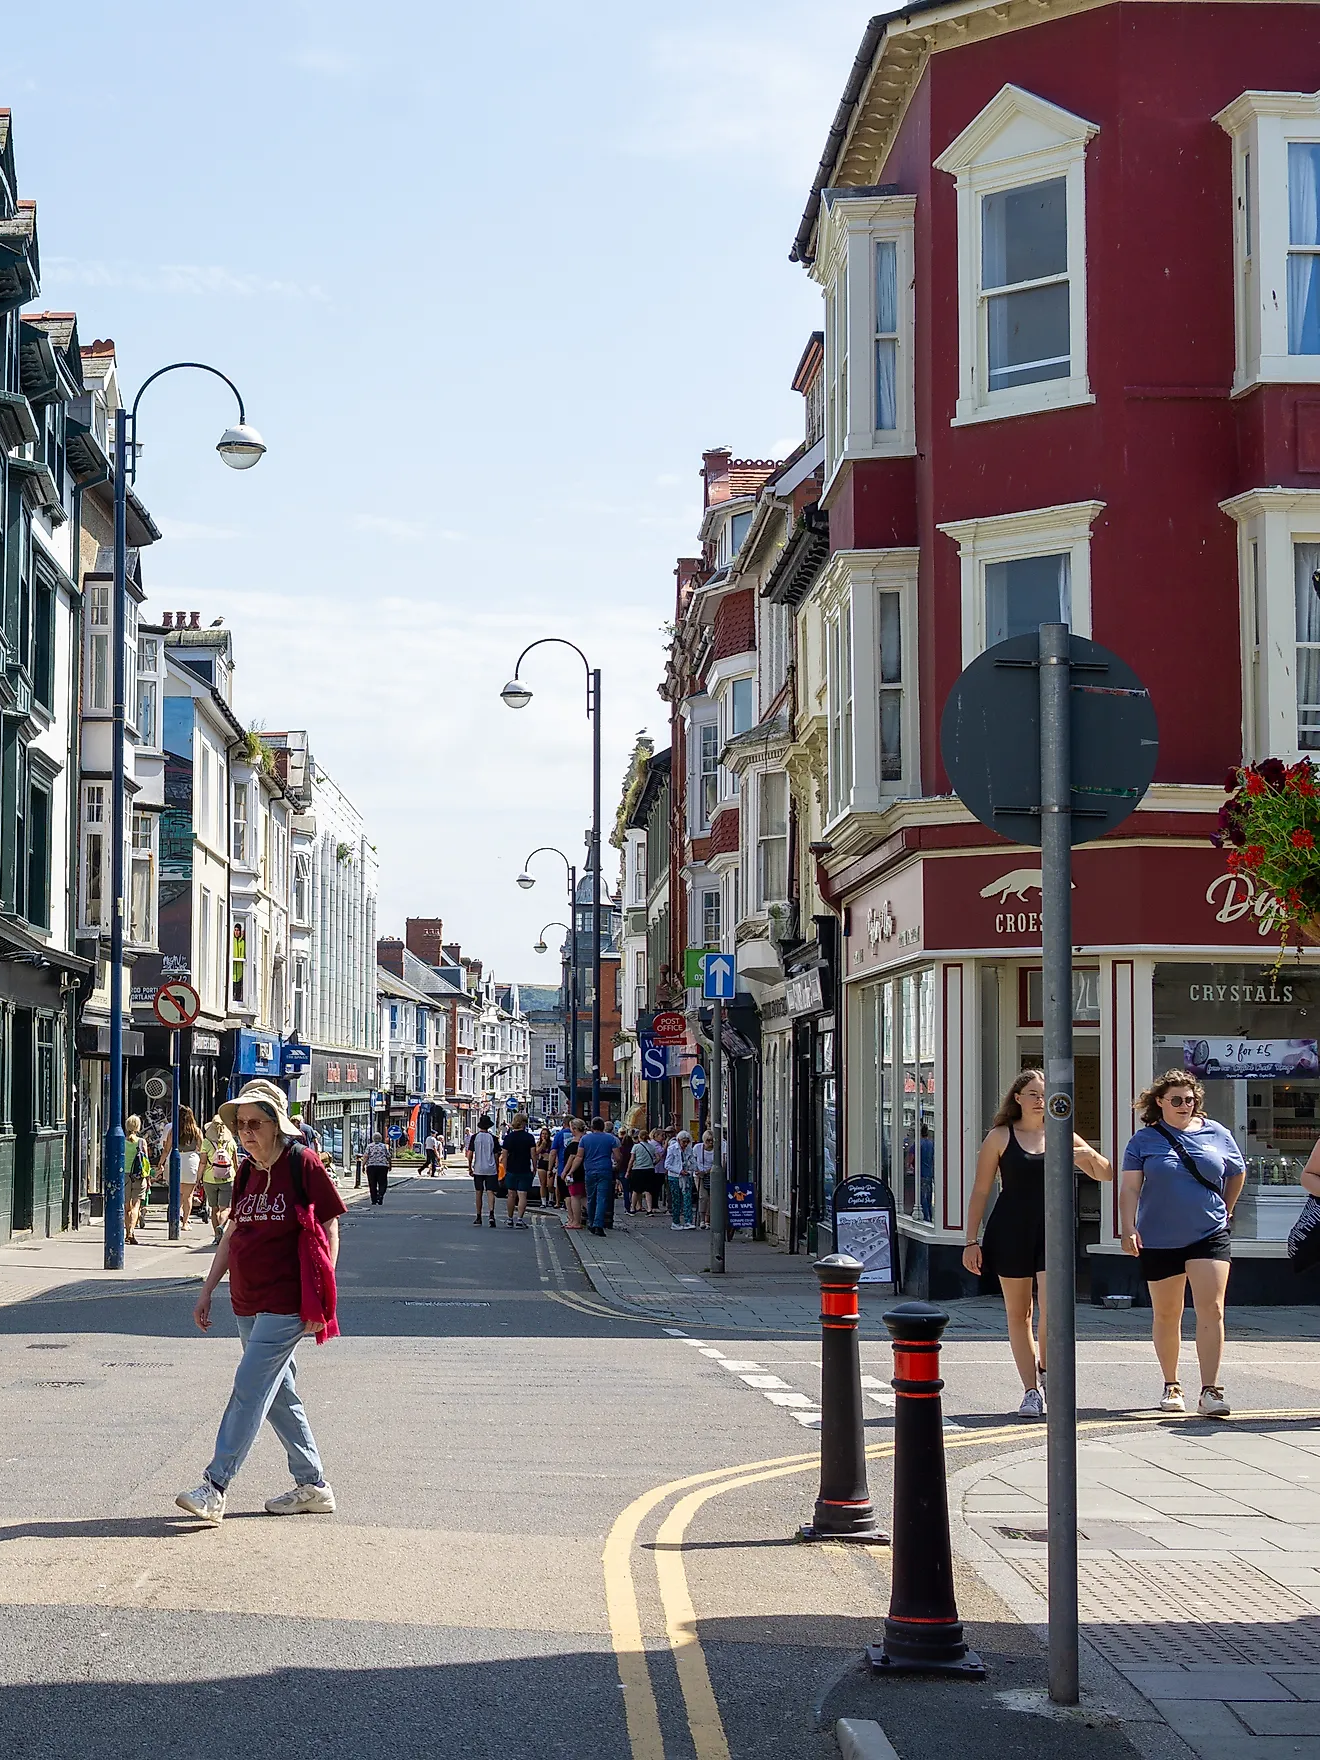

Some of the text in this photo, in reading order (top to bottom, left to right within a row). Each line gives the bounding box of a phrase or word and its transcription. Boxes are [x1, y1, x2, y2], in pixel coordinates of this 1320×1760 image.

[1189, 984, 1293, 1003] CRYSTALS
[657, 1024, 683, 1032] OFFICE
[1225, 1043, 1273, 1062] 3 for £5
